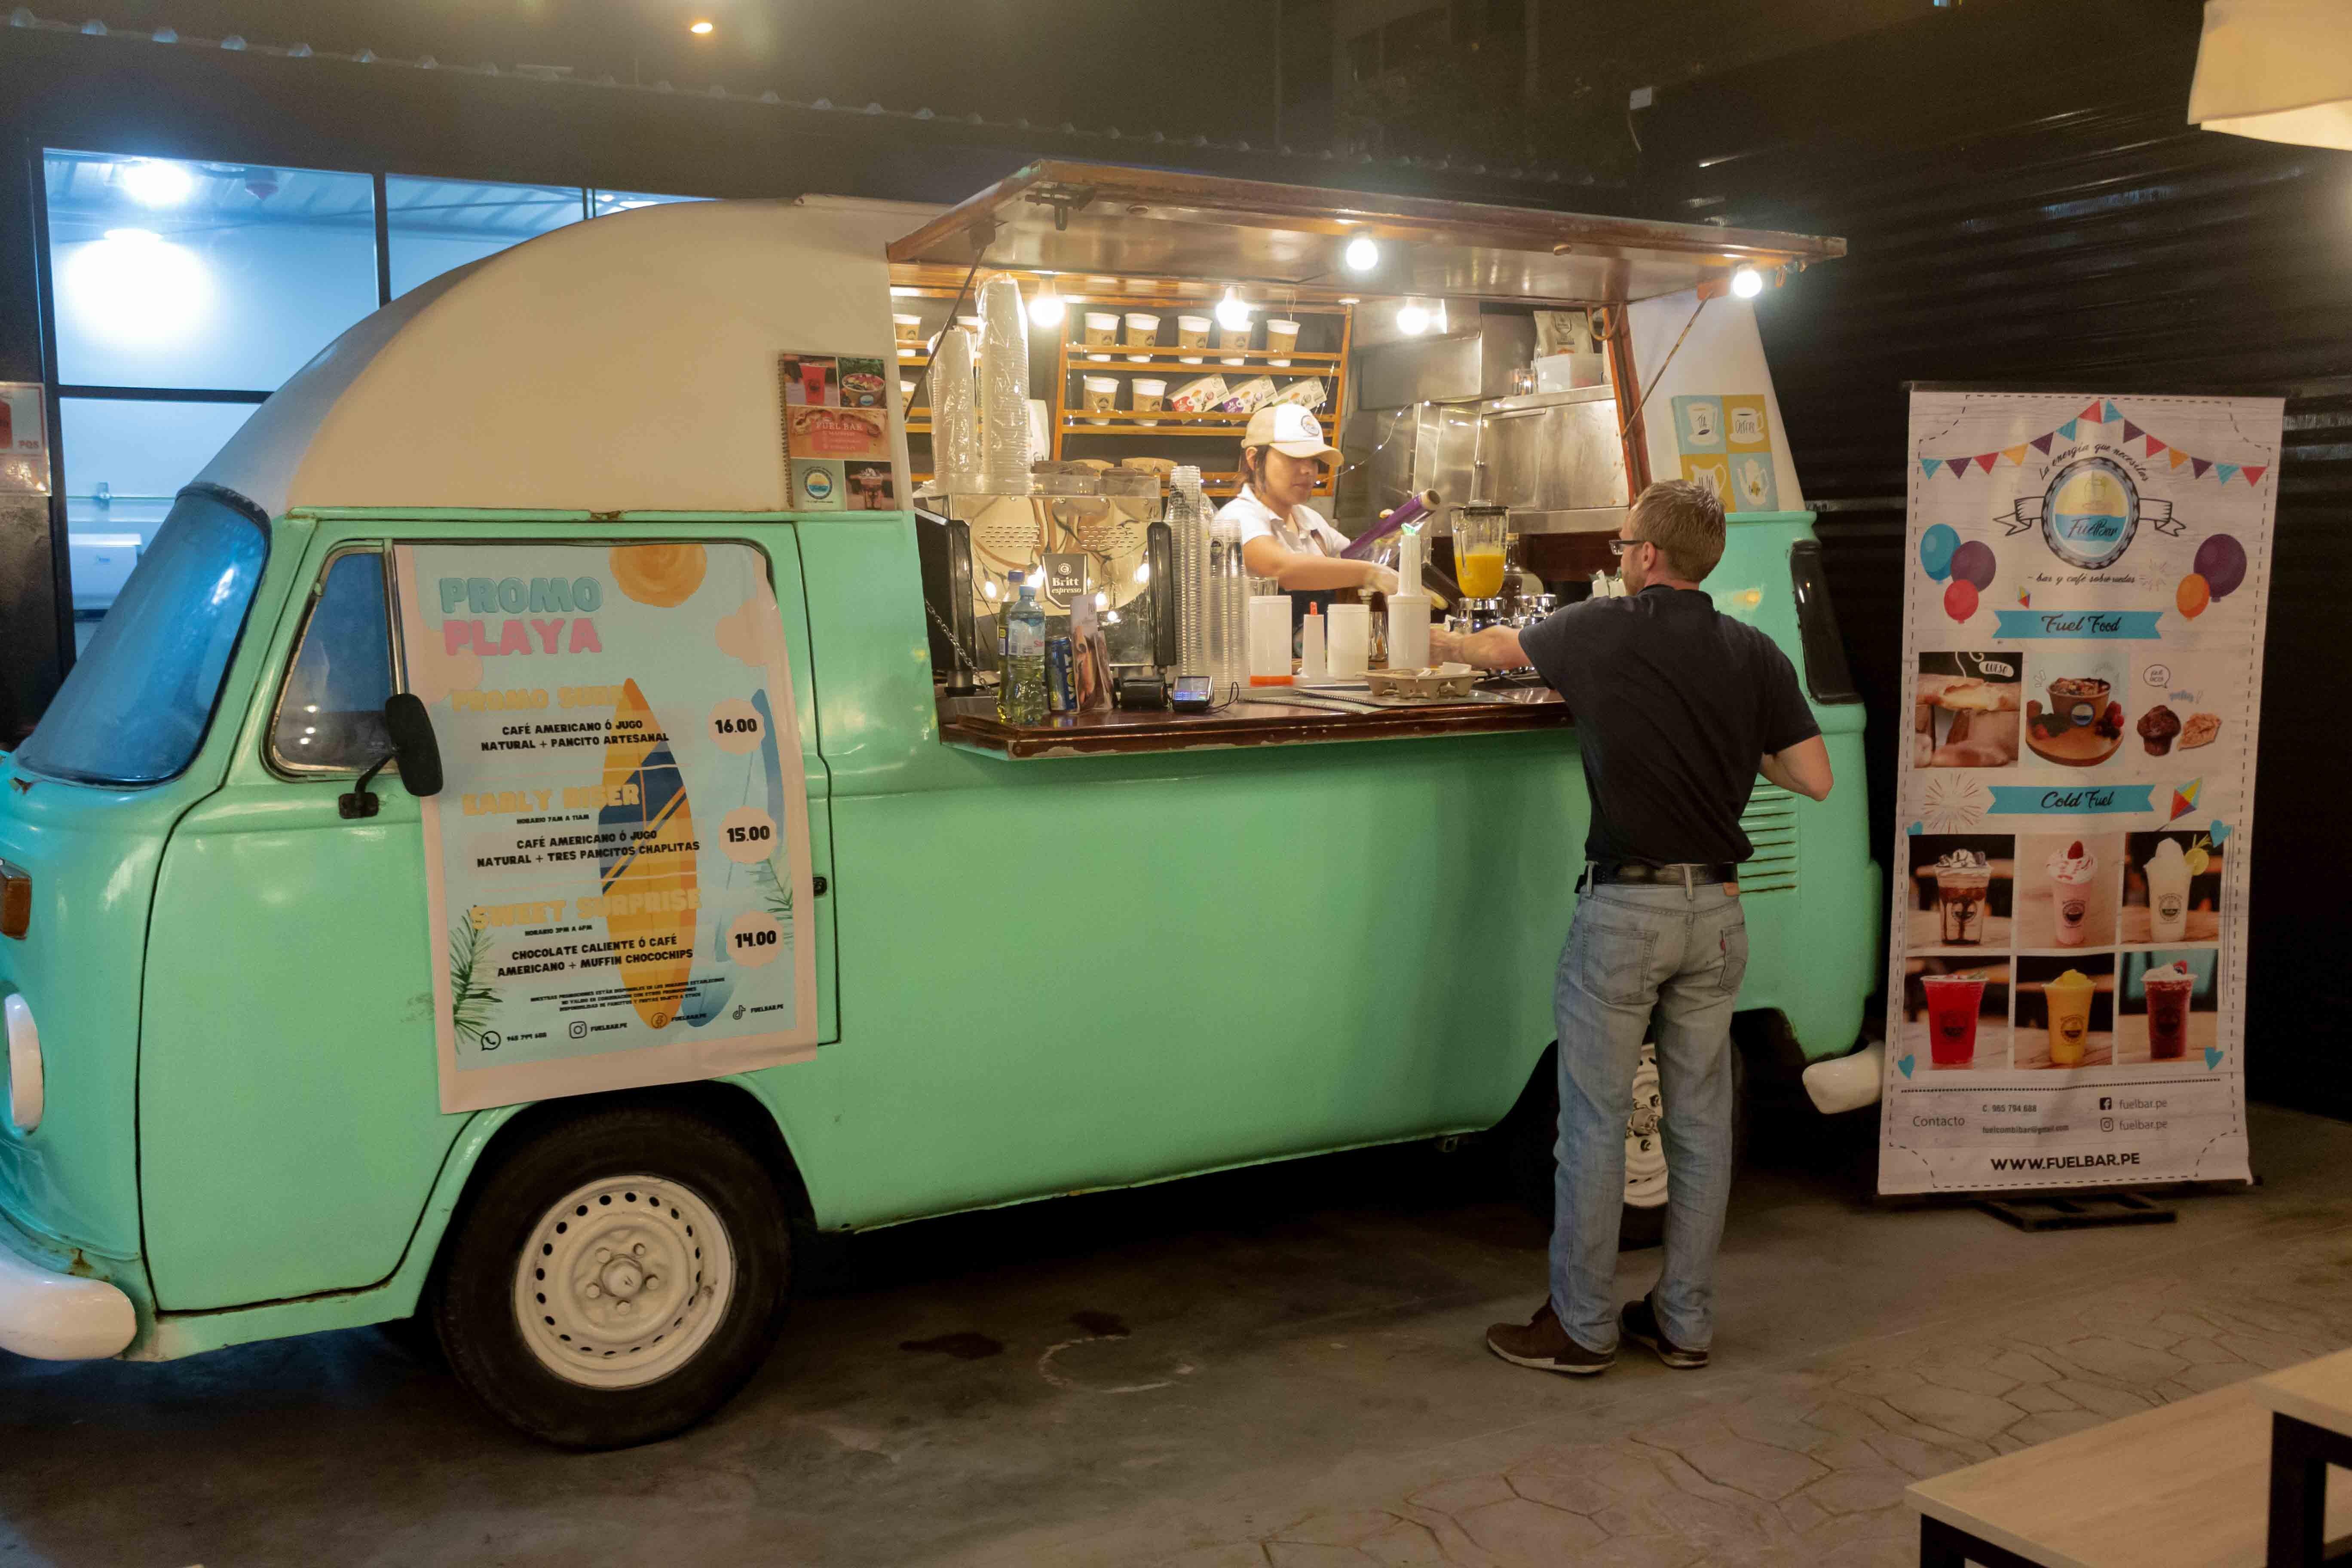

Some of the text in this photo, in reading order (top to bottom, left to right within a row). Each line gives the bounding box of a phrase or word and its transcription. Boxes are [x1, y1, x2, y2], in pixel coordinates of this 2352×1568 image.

[2095, 443, 2111, 454] que
[1052, 577, 1080, 587] Britt
[2036, 573, 2052, 582] bar
[439, 576, 602, 614] PROMO
[2041, 613, 2122, 633] Fuel Food
[443, 618, 602, 656] PLAYA
[451, 688, 550, 712] PROMO
[502, 719, 643, 735] CAFÉ AMERICANO Ó JUGO
[714, 718, 758, 734] 16.00
[481, 740, 536, 751] NATURAL
[551, 736, 600, 748] PANCITO
[603, 732, 670, 744] ARTESANAL
[461, 783, 640, 816] EARLY RISER
[2041, 789, 2114, 808] Cold Fuel
[517, 830, 657, 849] CAFÉ AMERICANO Ó JUGO
[726, 825, 770, 843] 15.00
[477, 855, 532, 868] NATURAL
[547, 850, 576, 863] TRES
[580, 845, 636, 860] PANCITOS
[639, 841, 700, 854] CHAPLITAS
[471, 888, 702, 931] SWEET SURPRISE
[524, 928, 554, 937] HORARIO
[735, 930, 777, 948] 14.00
[511, 933, 677, 961] CHOCOLATE CALIENTE Ó CAFÉ
[497, 961, 566, 977] AMERICANO
[580, 955, 622, 969] MUFFIN
[625, 949, 694, 964] CHOCOCHIPS
[2008, 1104, 2021, 1112] 794
[2119, 1099, 2168, 1110] fuelbar.pe
[1913, 1116, 1965, 1127] Contacto
[2119, 1119, 2168, 1131] fuelbar.pe
[1990, 1153, 2141, 1170] WWW.FUELBAR.PE
